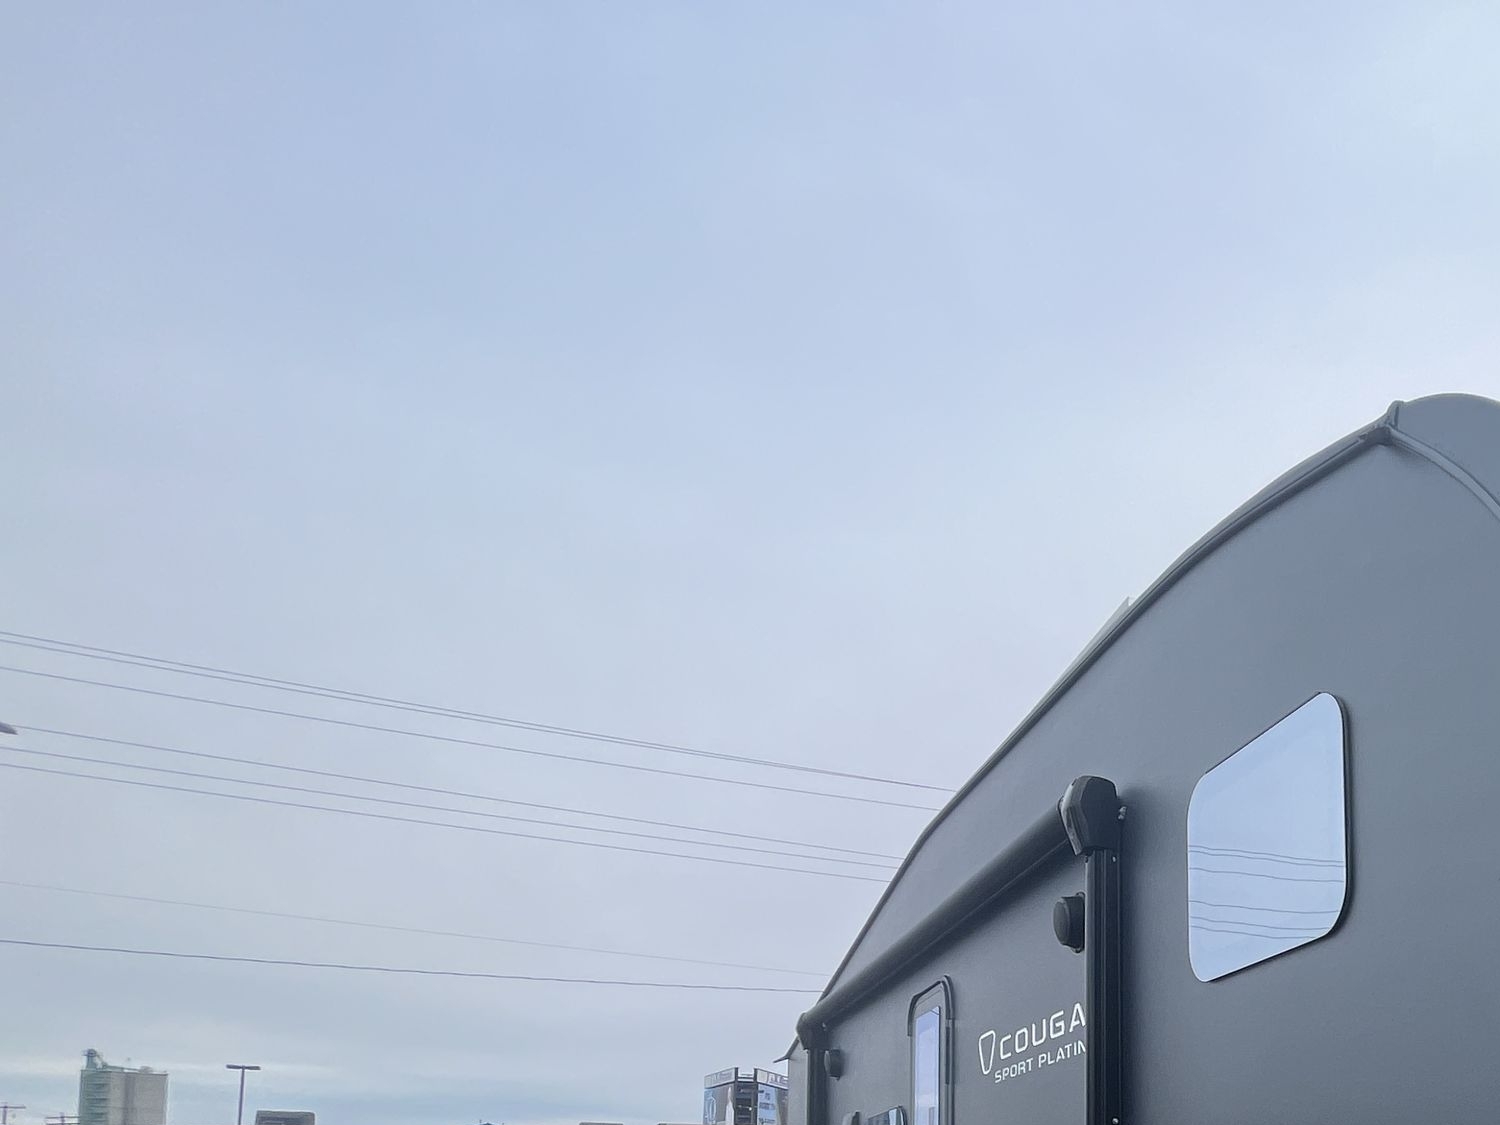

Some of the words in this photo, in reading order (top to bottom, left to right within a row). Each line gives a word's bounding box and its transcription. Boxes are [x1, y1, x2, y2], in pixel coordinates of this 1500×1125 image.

[1000, 1002, 1086, 1060] COUGA
[994, 1057, 1034, 1084] SPORT
[1038, 1040, 1086, 1068] PLATIN
